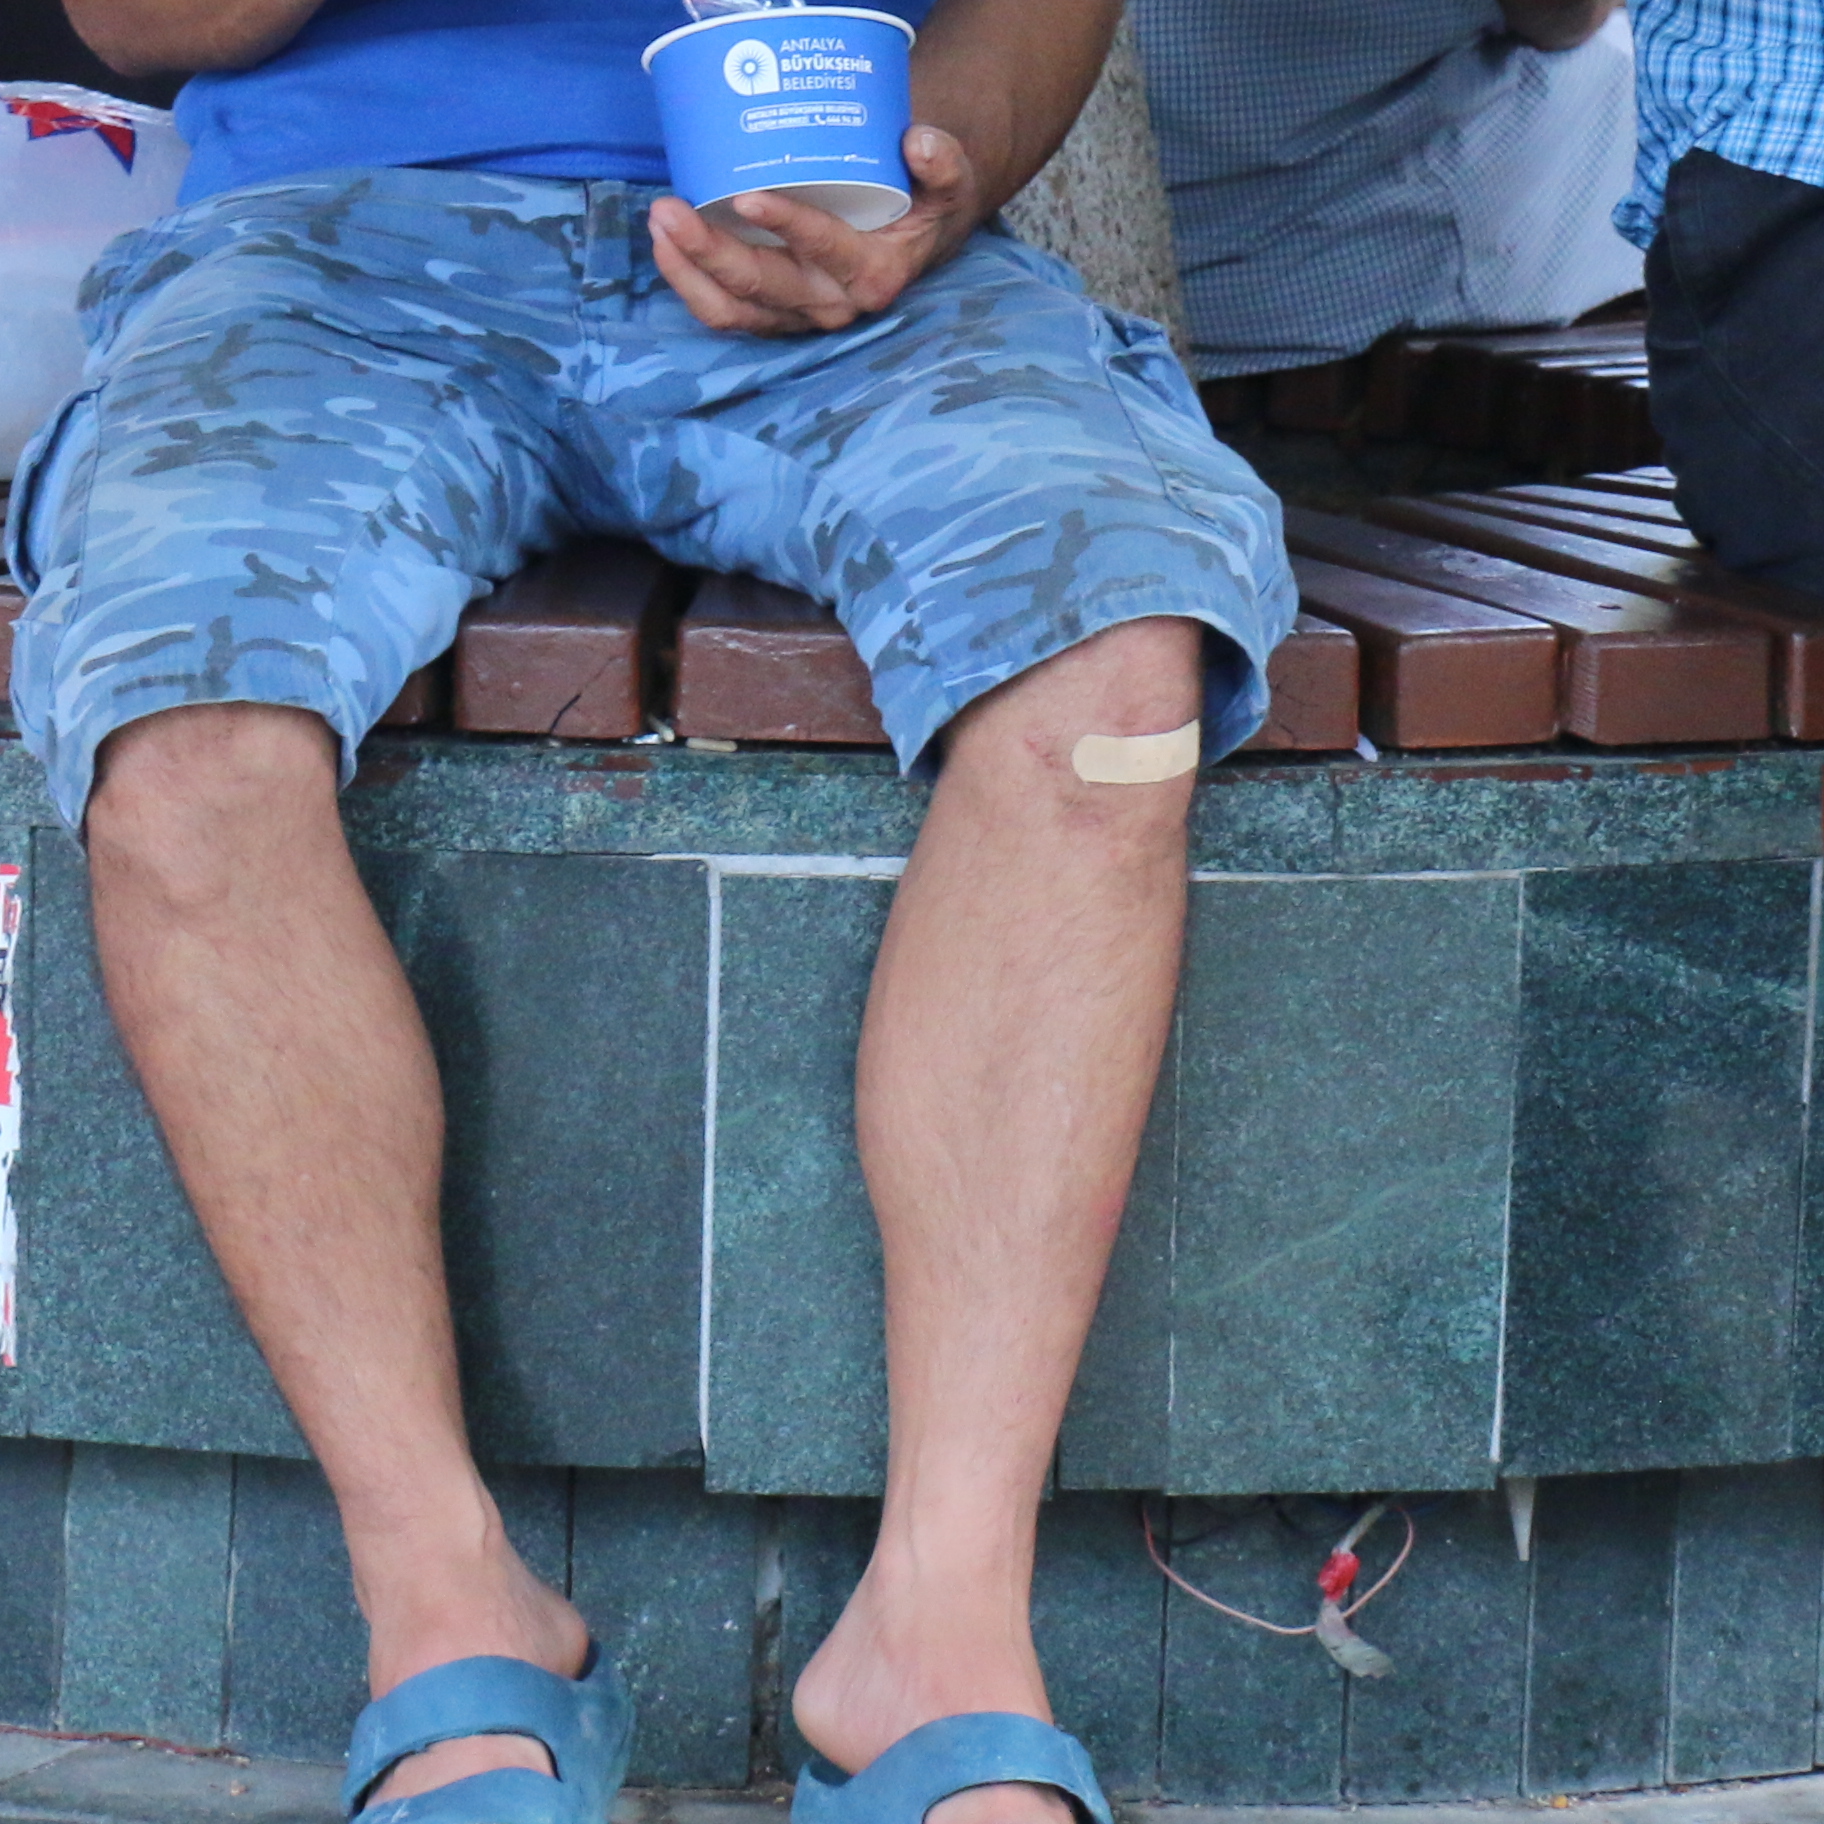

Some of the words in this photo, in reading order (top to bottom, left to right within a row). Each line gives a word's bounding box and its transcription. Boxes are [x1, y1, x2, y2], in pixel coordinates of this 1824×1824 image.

[780, 37, 846, 52] ANTALYA
[780, 54, 873, 75] BÜYÜKŞEHİR
[783, 73, 857, 90] BELEDİYESİ
